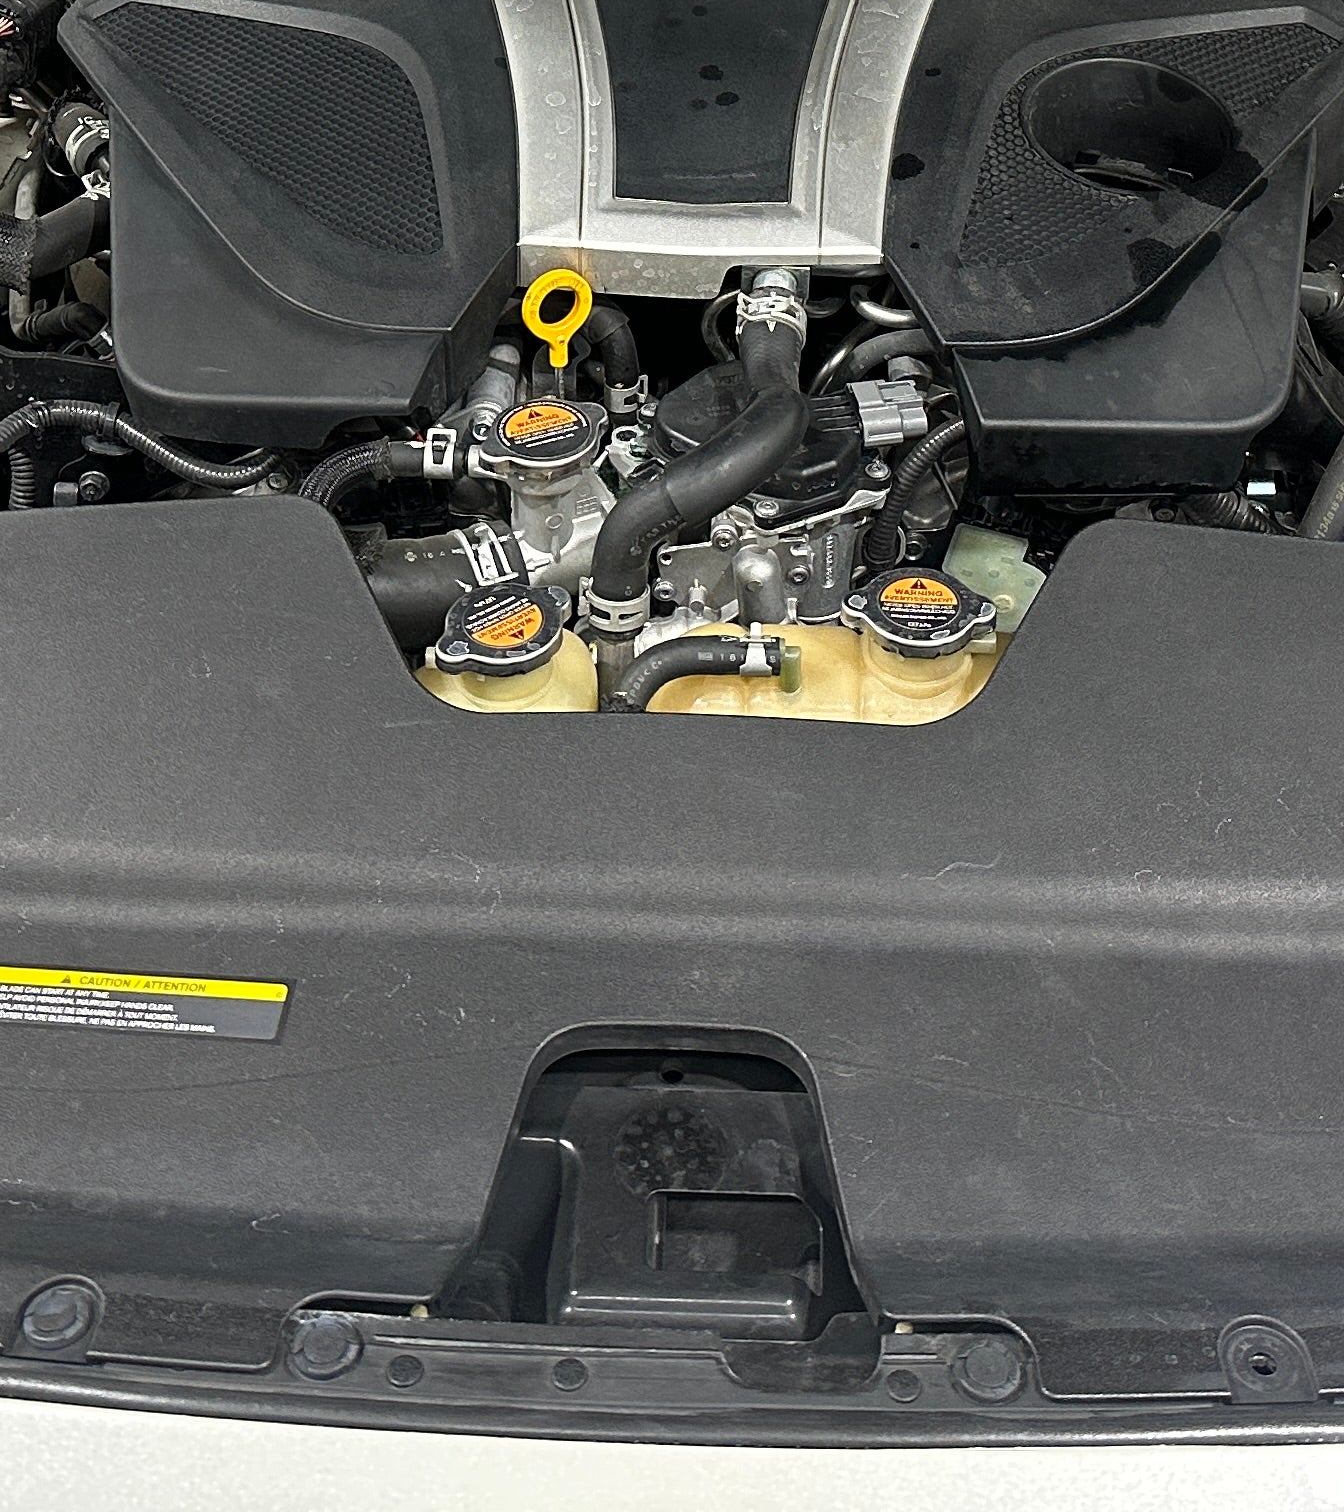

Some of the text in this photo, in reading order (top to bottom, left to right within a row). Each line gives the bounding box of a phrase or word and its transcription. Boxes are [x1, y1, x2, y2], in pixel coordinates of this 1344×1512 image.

[516, 413, 560, 428] WARNING
[894, 588, 944, 597] WARNING
[490, 618, 536, 640] WARNING
[79, 975, 132, 988] CAUTION
[143, 980, 207, 992] ATTENTION
